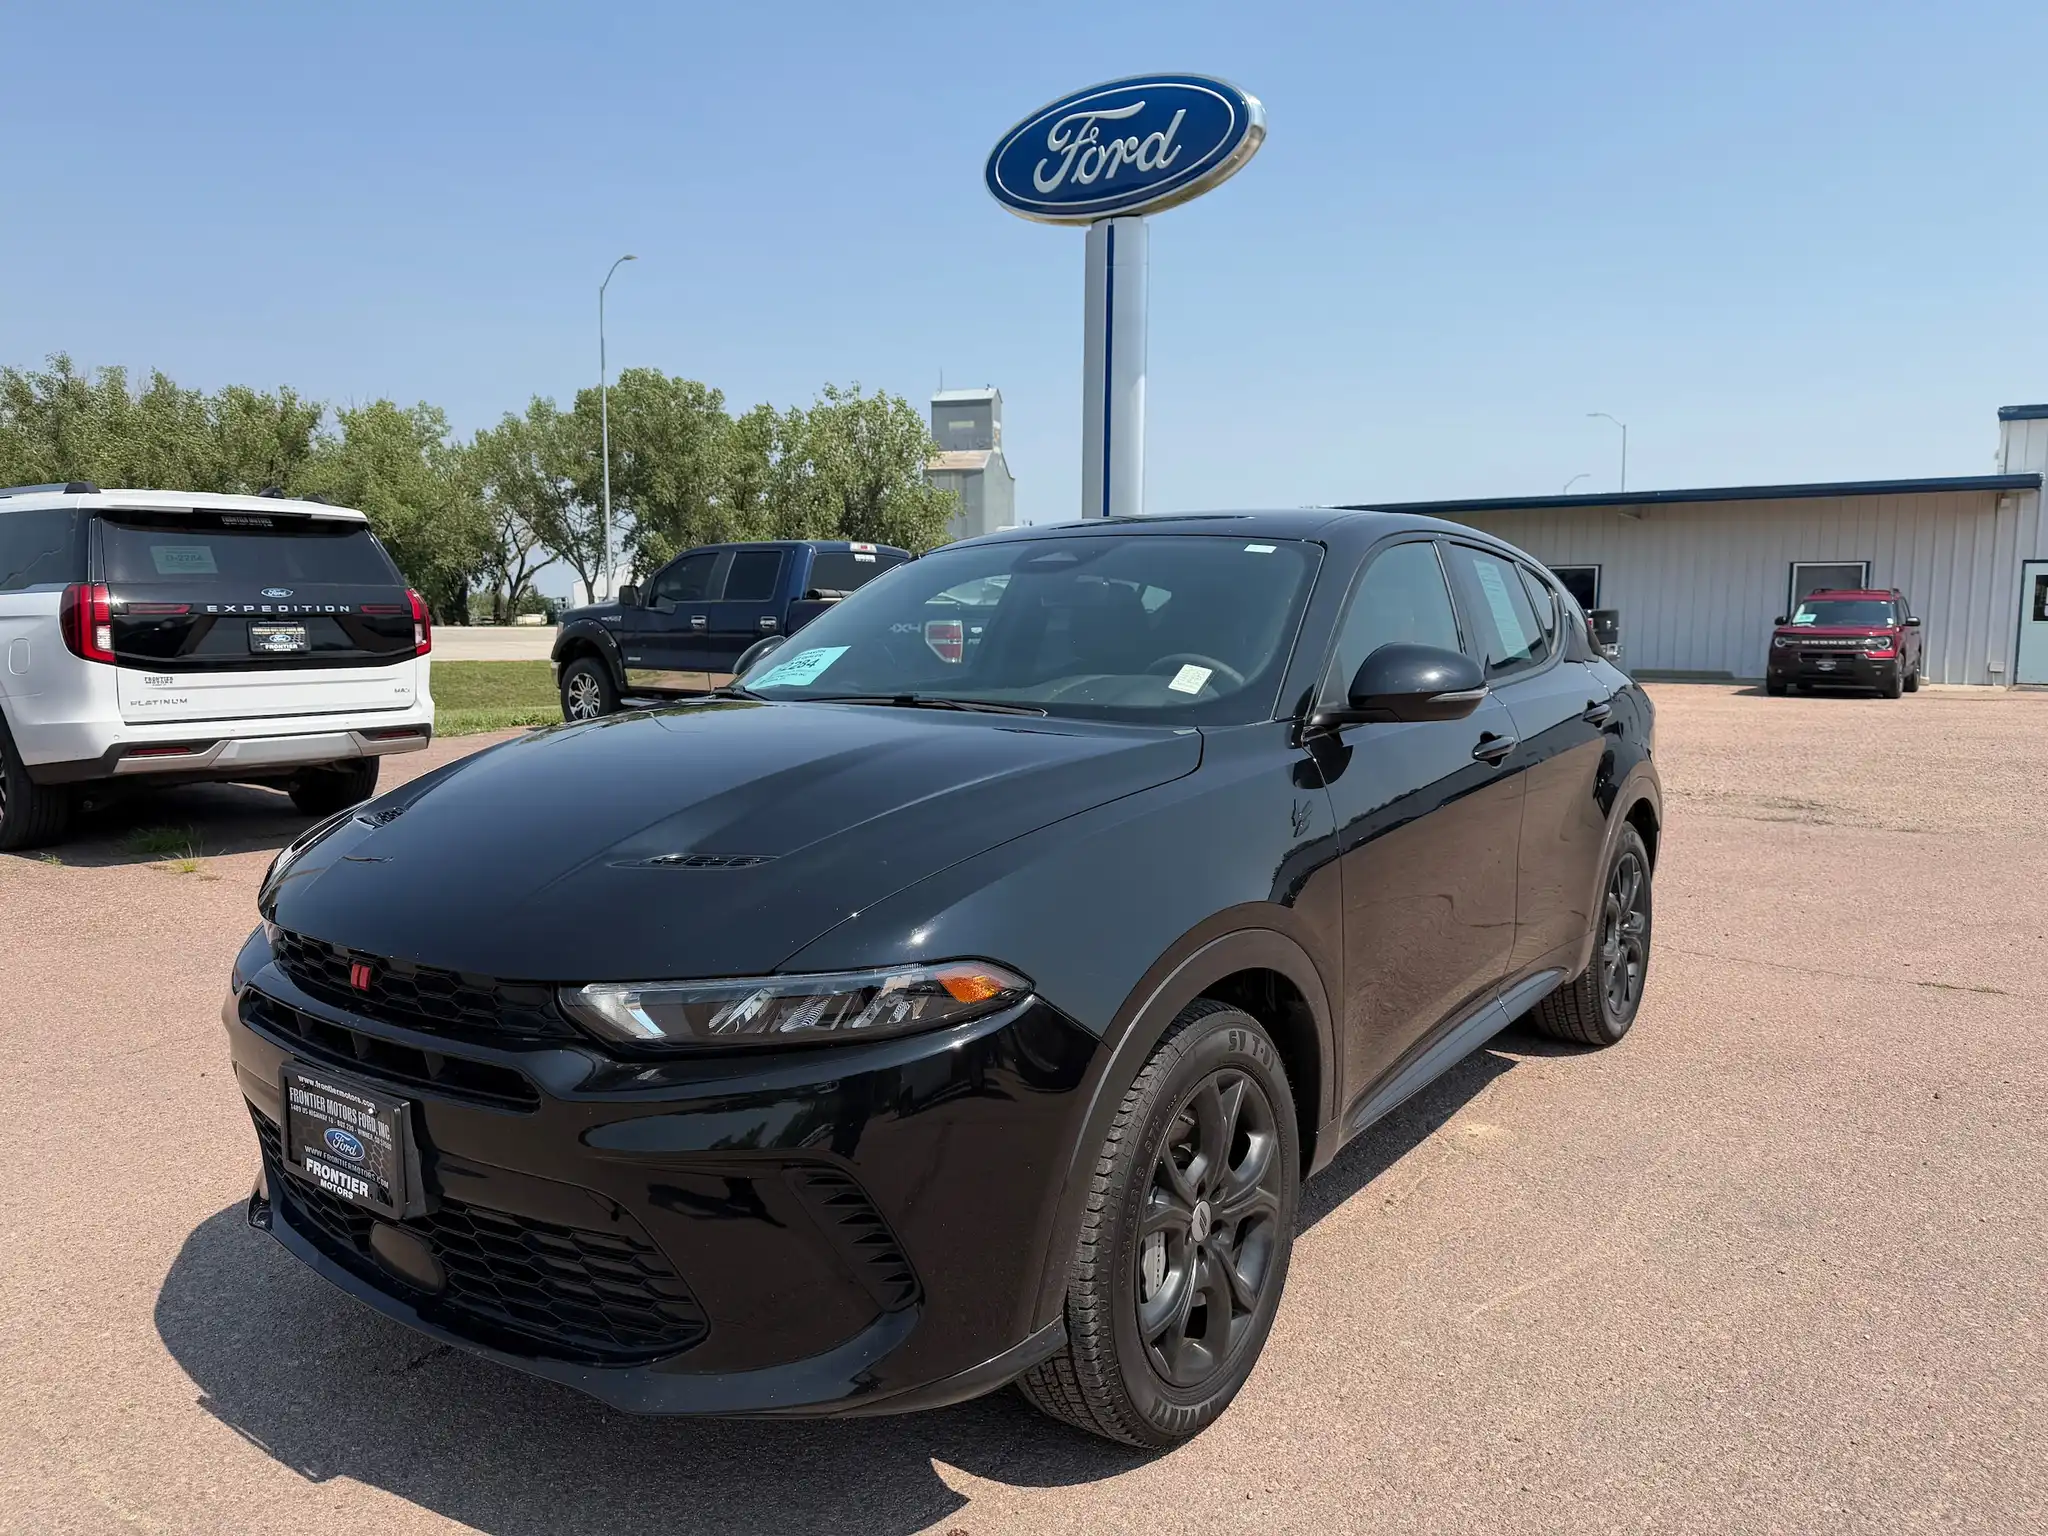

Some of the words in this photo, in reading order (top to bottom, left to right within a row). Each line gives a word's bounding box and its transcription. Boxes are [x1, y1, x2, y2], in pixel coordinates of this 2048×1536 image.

[1033, 100, 1187, 193] Ford
[206, 605, 350, 613] EXPEDITION
[130, 698, 188, 706] PLATINUM
[289, 1086, 326, 1113] FRONTIER
[326, 1099, 358, 1125] MOTORS
[332, 1132, 357, 1156] Ford
[306, 1157, 369, 1198] FRONTIER
[320, 1178, 354, 1200] MOTORS
